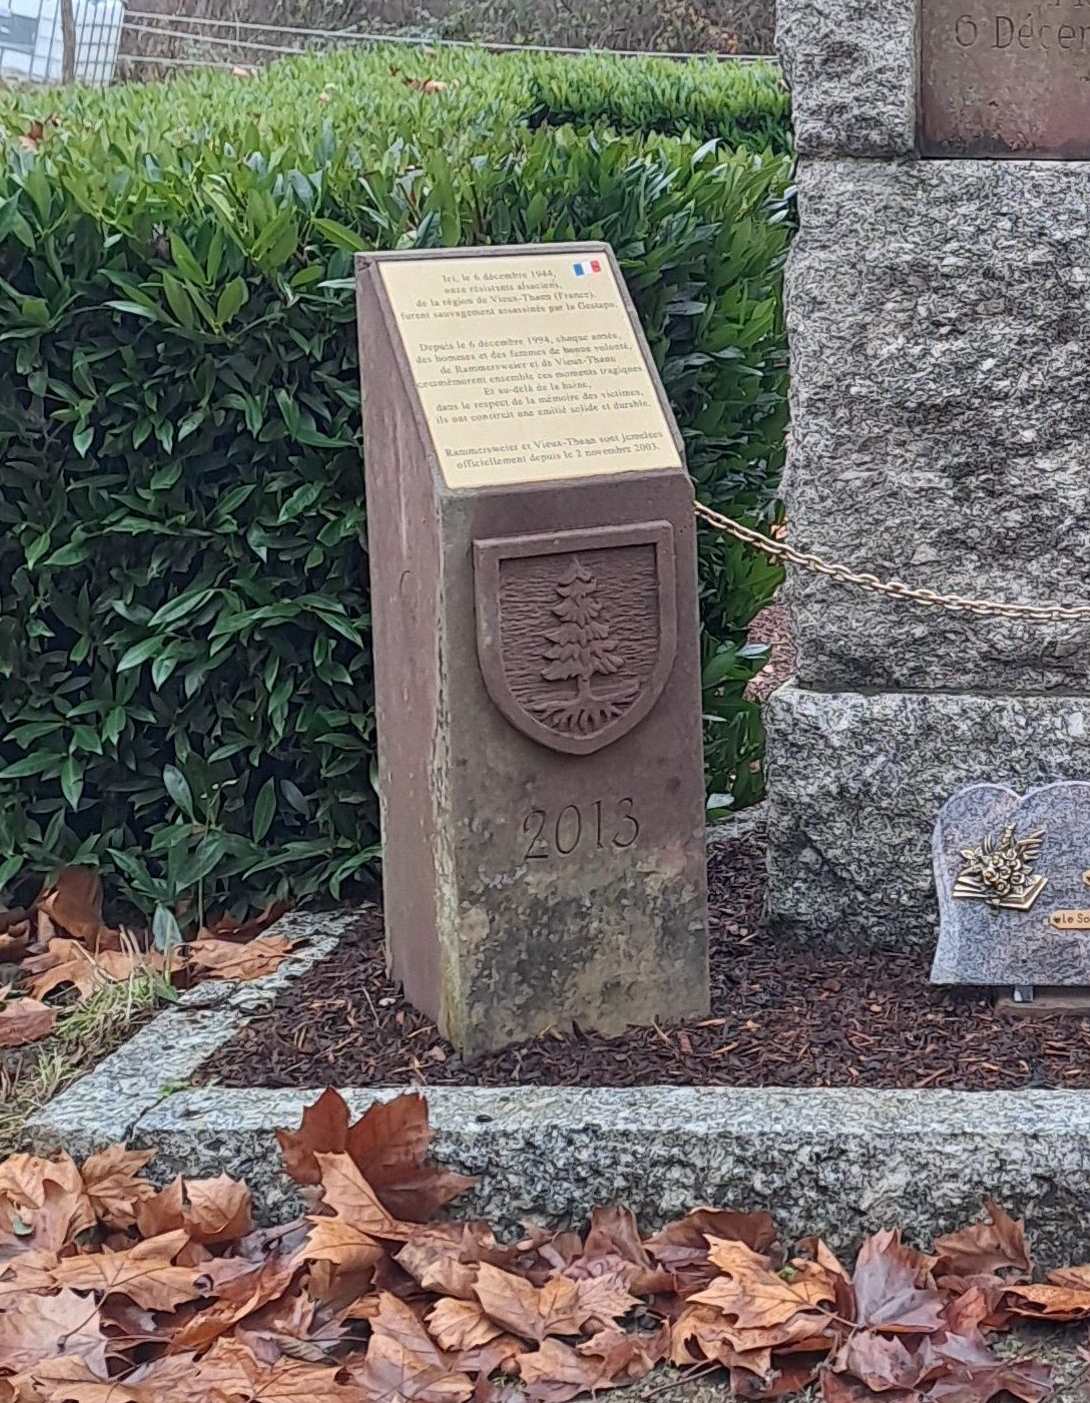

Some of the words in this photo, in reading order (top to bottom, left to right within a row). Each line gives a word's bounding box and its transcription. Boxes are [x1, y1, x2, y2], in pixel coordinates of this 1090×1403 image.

[419, 342, 454, 353] Depuis
[575, 449, 583, 458] 2
[522, 797, 640, 860] 2013
[1062, 913, 1074, 925] Le
